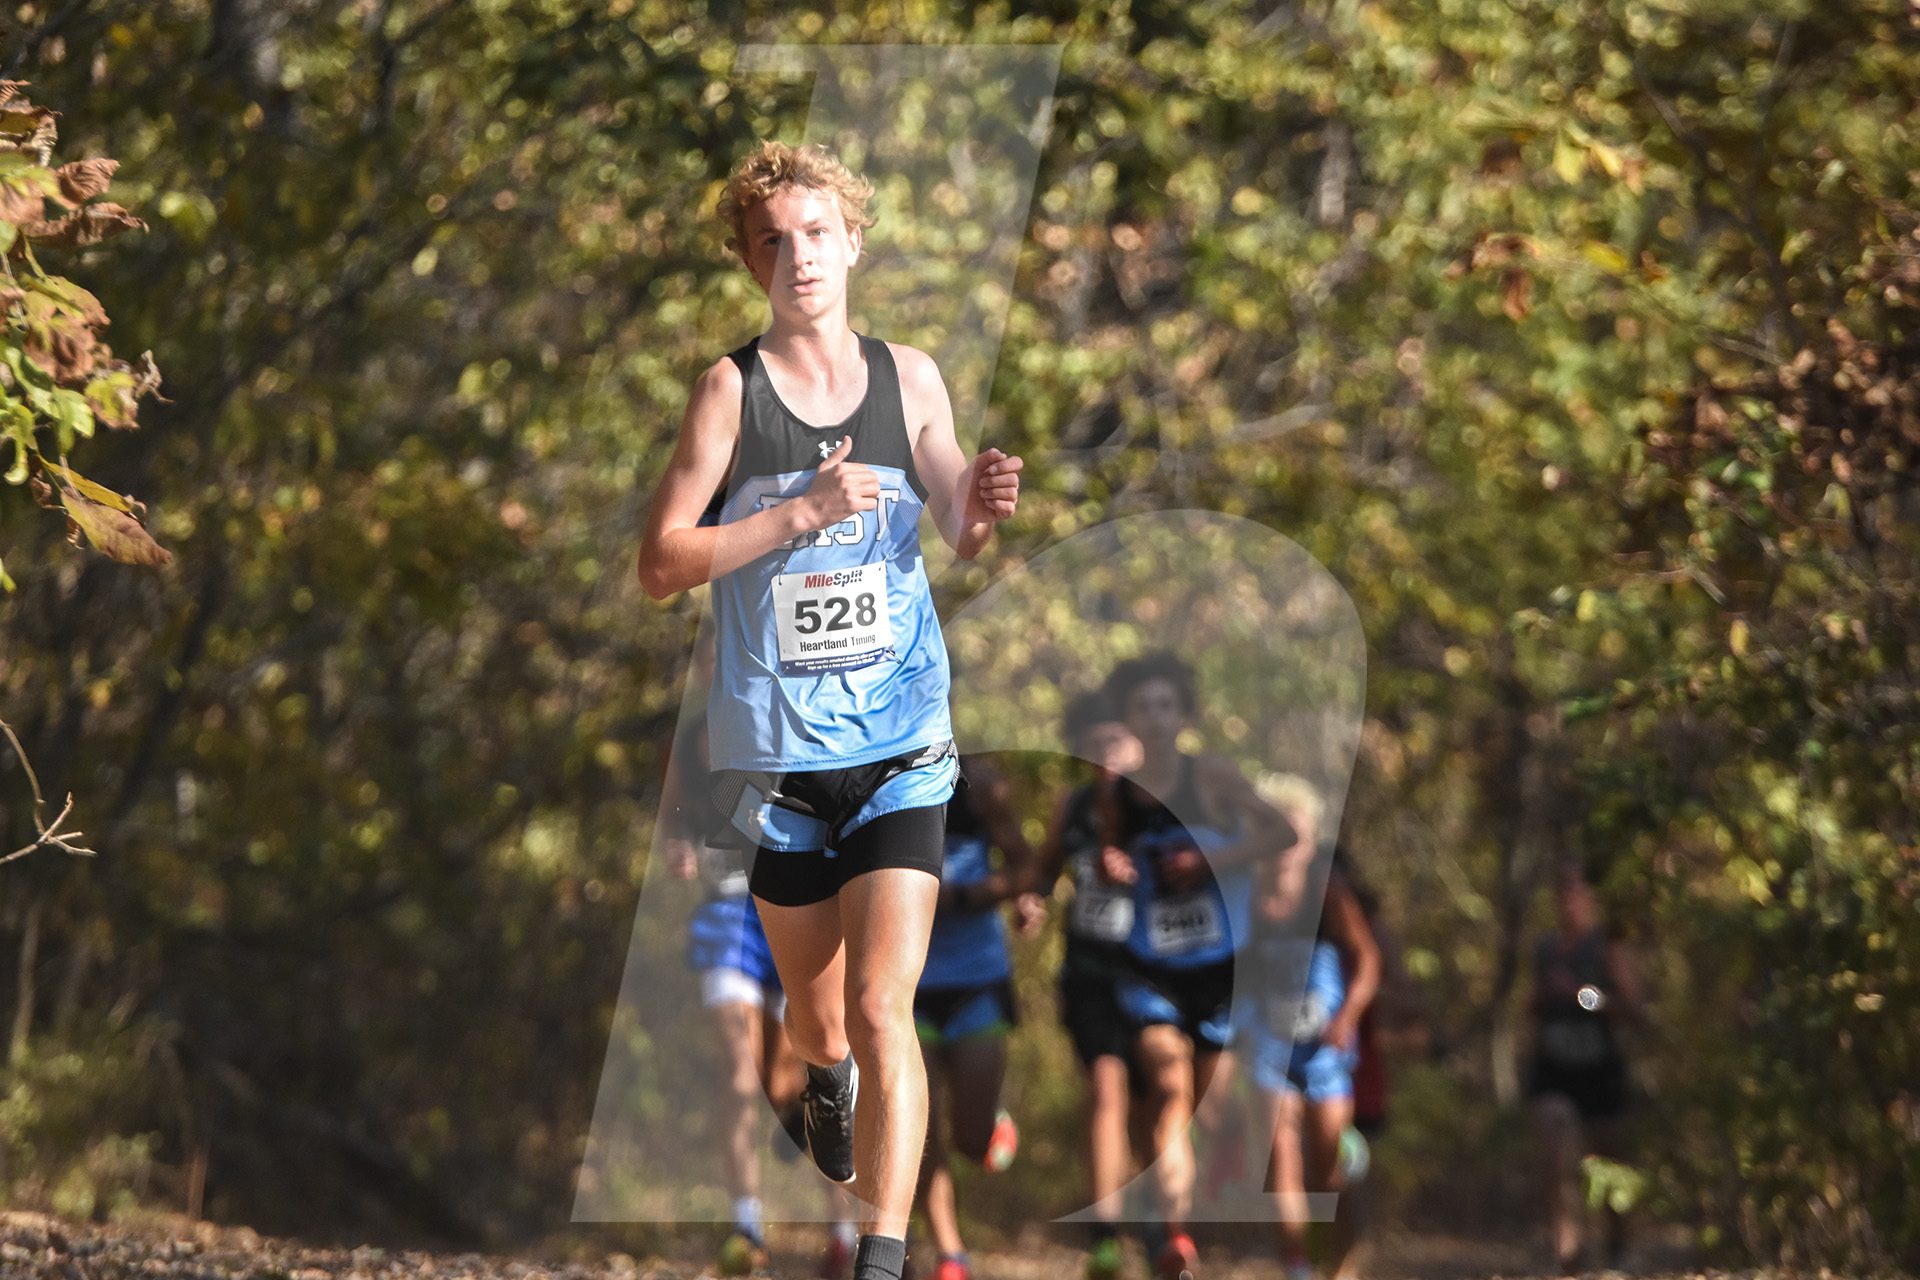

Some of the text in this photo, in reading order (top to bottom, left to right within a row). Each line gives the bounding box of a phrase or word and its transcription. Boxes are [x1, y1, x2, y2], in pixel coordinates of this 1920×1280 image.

[804, 569, 863, 588] MileSplit
[794, 592, 877, 635] 528
[800, 634, 876, 652] Heartland Timing
